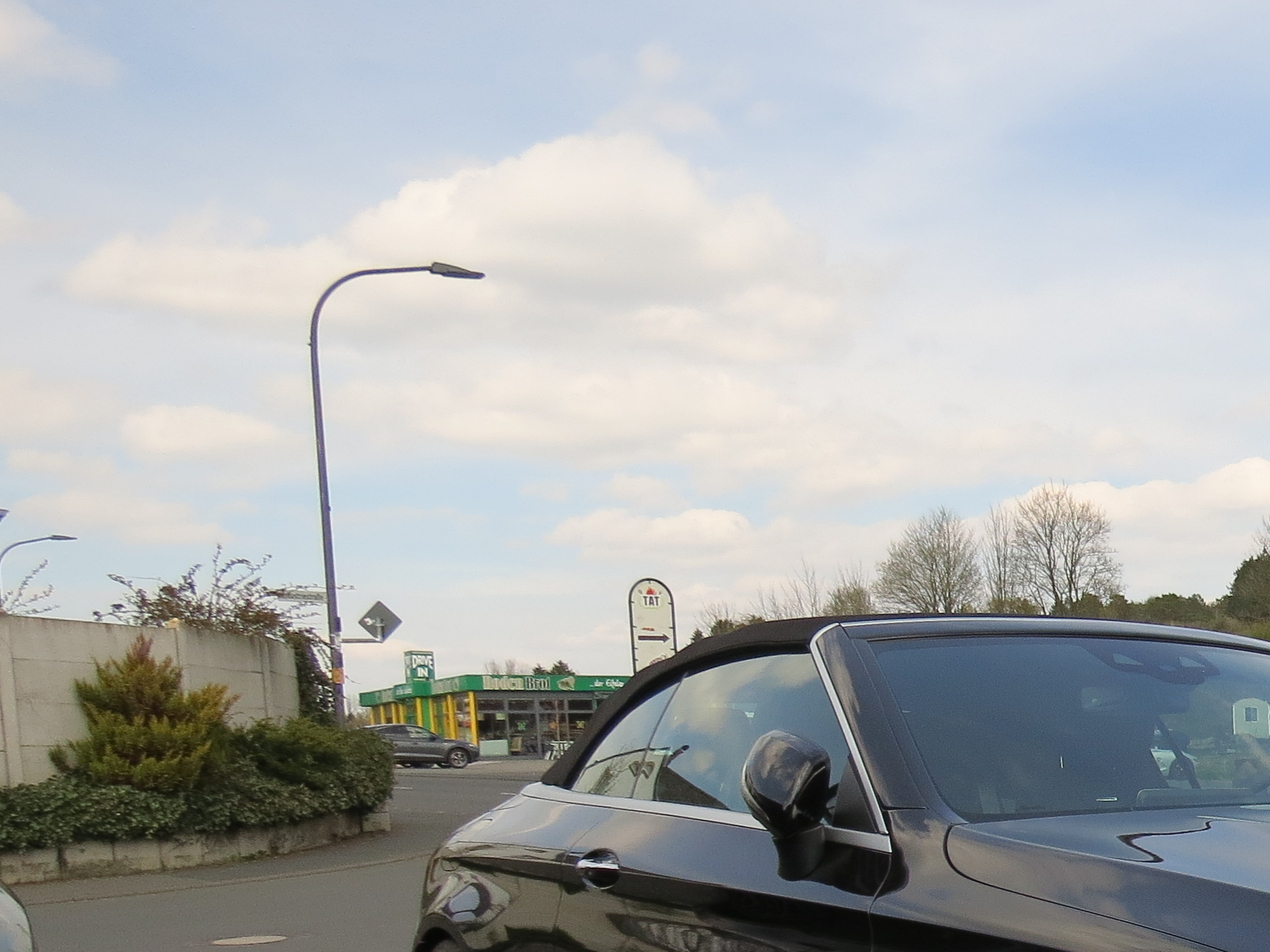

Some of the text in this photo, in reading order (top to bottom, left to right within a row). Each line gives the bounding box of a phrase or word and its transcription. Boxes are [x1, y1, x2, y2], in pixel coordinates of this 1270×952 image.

[643, 596, 660, 606] TAT
[412, 655, 434, 669] DRIVE
[417, 667, 429, 677] IN
